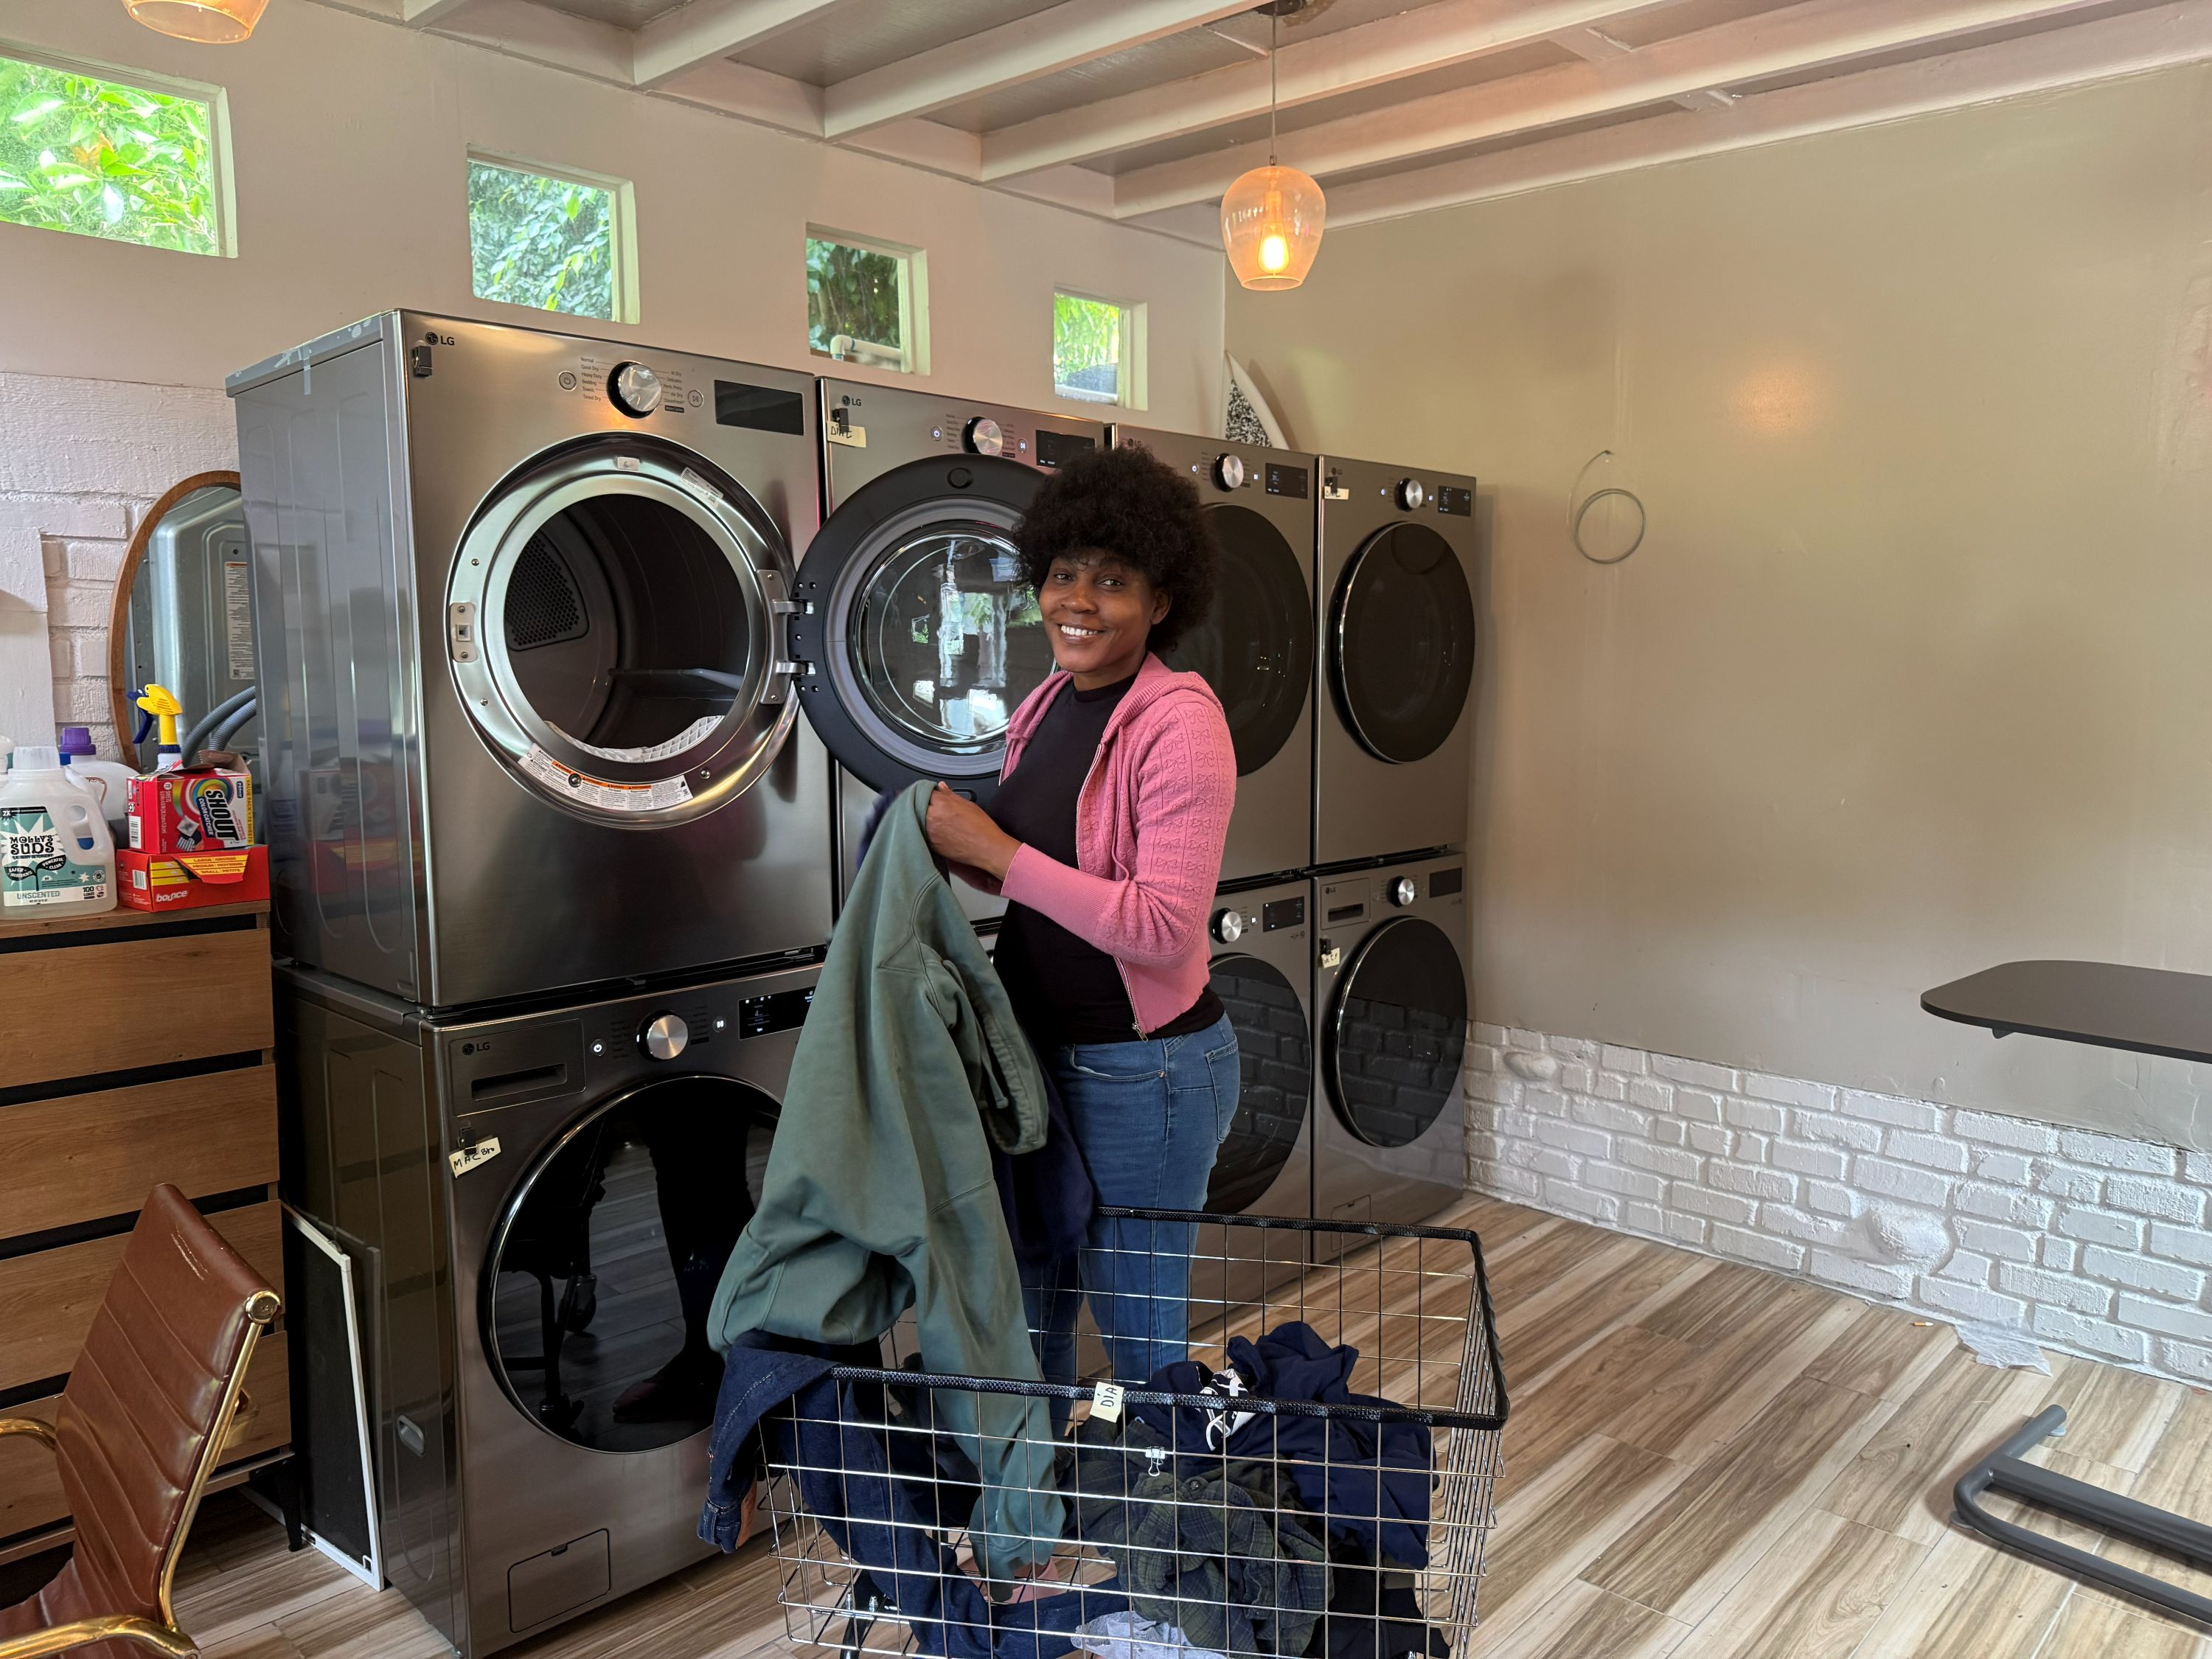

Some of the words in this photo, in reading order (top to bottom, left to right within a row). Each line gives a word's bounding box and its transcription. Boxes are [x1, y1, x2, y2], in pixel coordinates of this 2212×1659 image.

[440, 335, 455, 346] LG
[852, 397, 862, 406] LG
[198, 798, 208, 815] COLOR
[203, 814, 214, 836] CATCHER
[206, 790, 240, 841] SHOUT
[10, 835, 54, 844] MOLLY'S
[10, 841, 55, 855] SUDS
[42, 858, 64, 866] POWERFUL
[17, 891, 60, 900] UNSCENTED
[156, 890, 188, 902] bounce
[476, 1042, 490, 1051] LG
